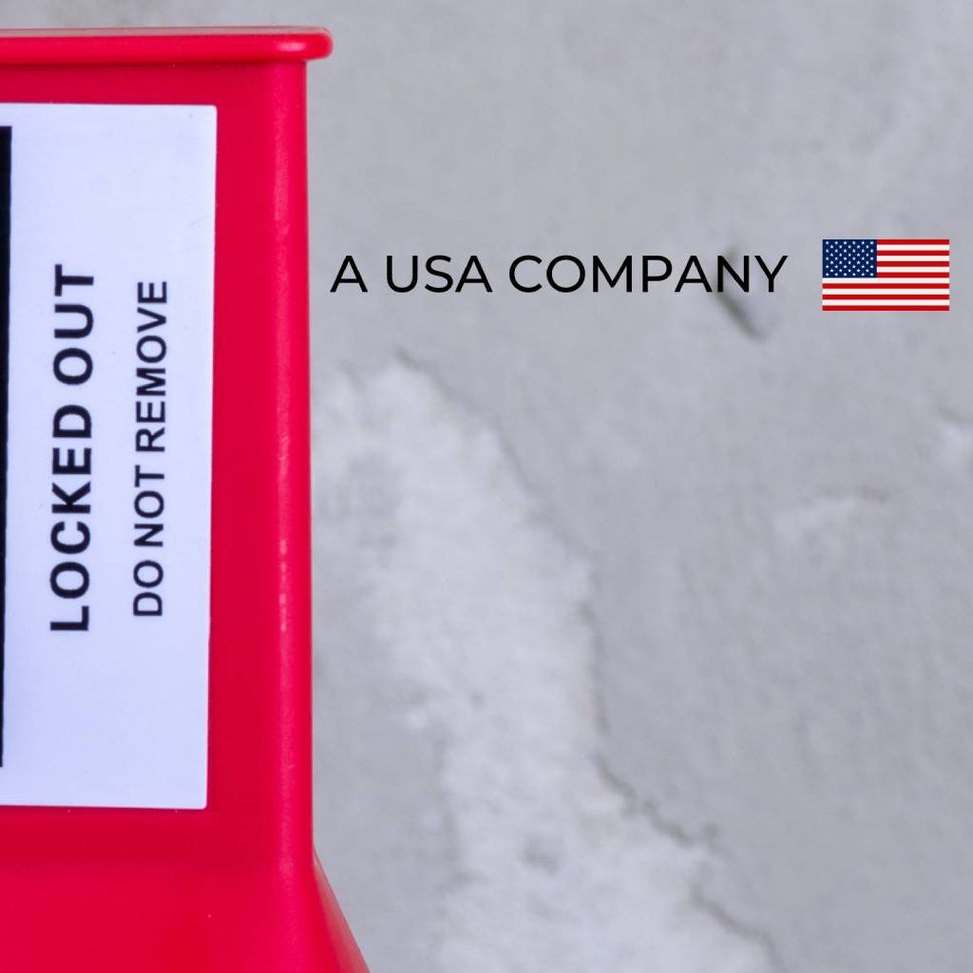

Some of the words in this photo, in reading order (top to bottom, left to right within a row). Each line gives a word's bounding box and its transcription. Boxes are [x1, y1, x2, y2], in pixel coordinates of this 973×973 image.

[53, 264, 94, 385] OUT
[135, 281, 167, 452] REMOVE
[49, 404, 92, 631] LOCKED
[134, 465, 165, 547] NOT
[133, 560, 164, 617] DO
